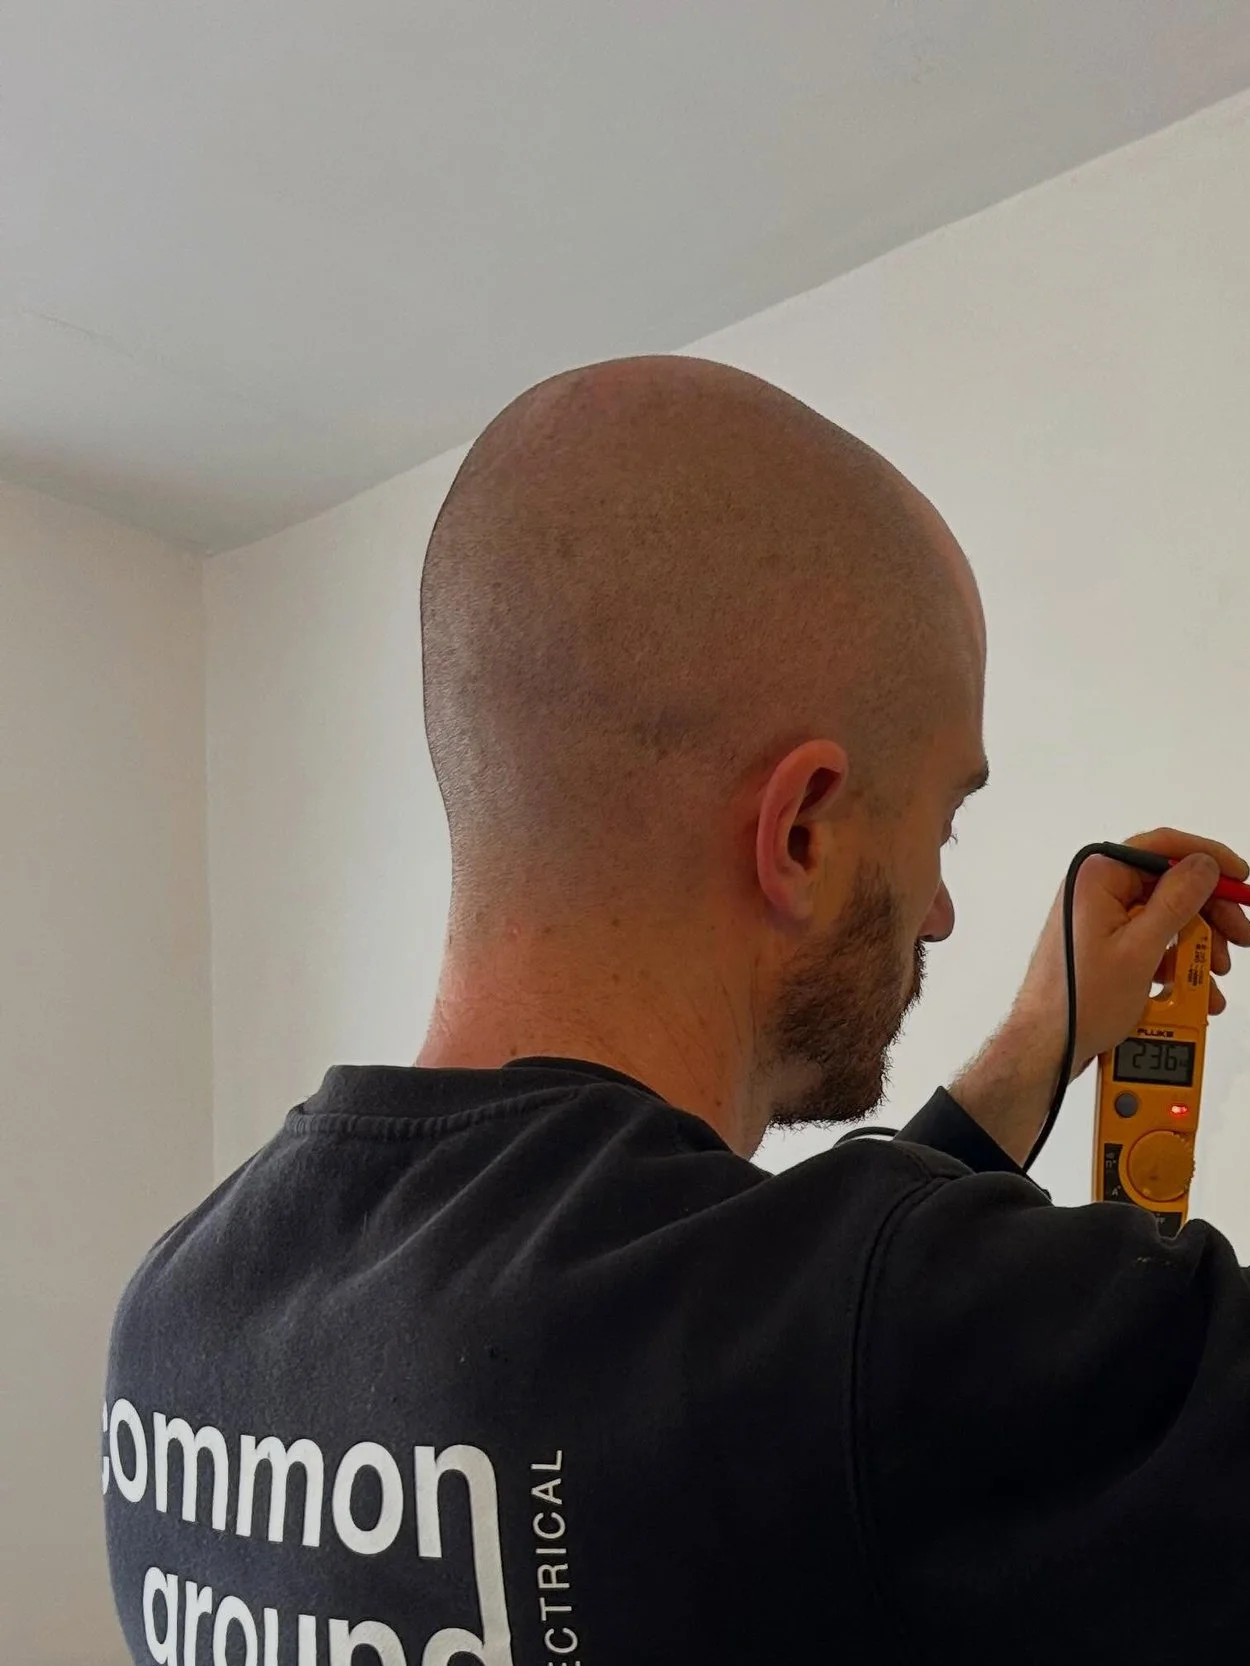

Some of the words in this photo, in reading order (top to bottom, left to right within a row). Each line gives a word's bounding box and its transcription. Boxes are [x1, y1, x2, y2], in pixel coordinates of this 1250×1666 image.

[1137, 1028, 1174, 1038] FLUKE
[1132, 1041, 1178, 1071] 236
[101, 1398, 501, 1559] ommon
